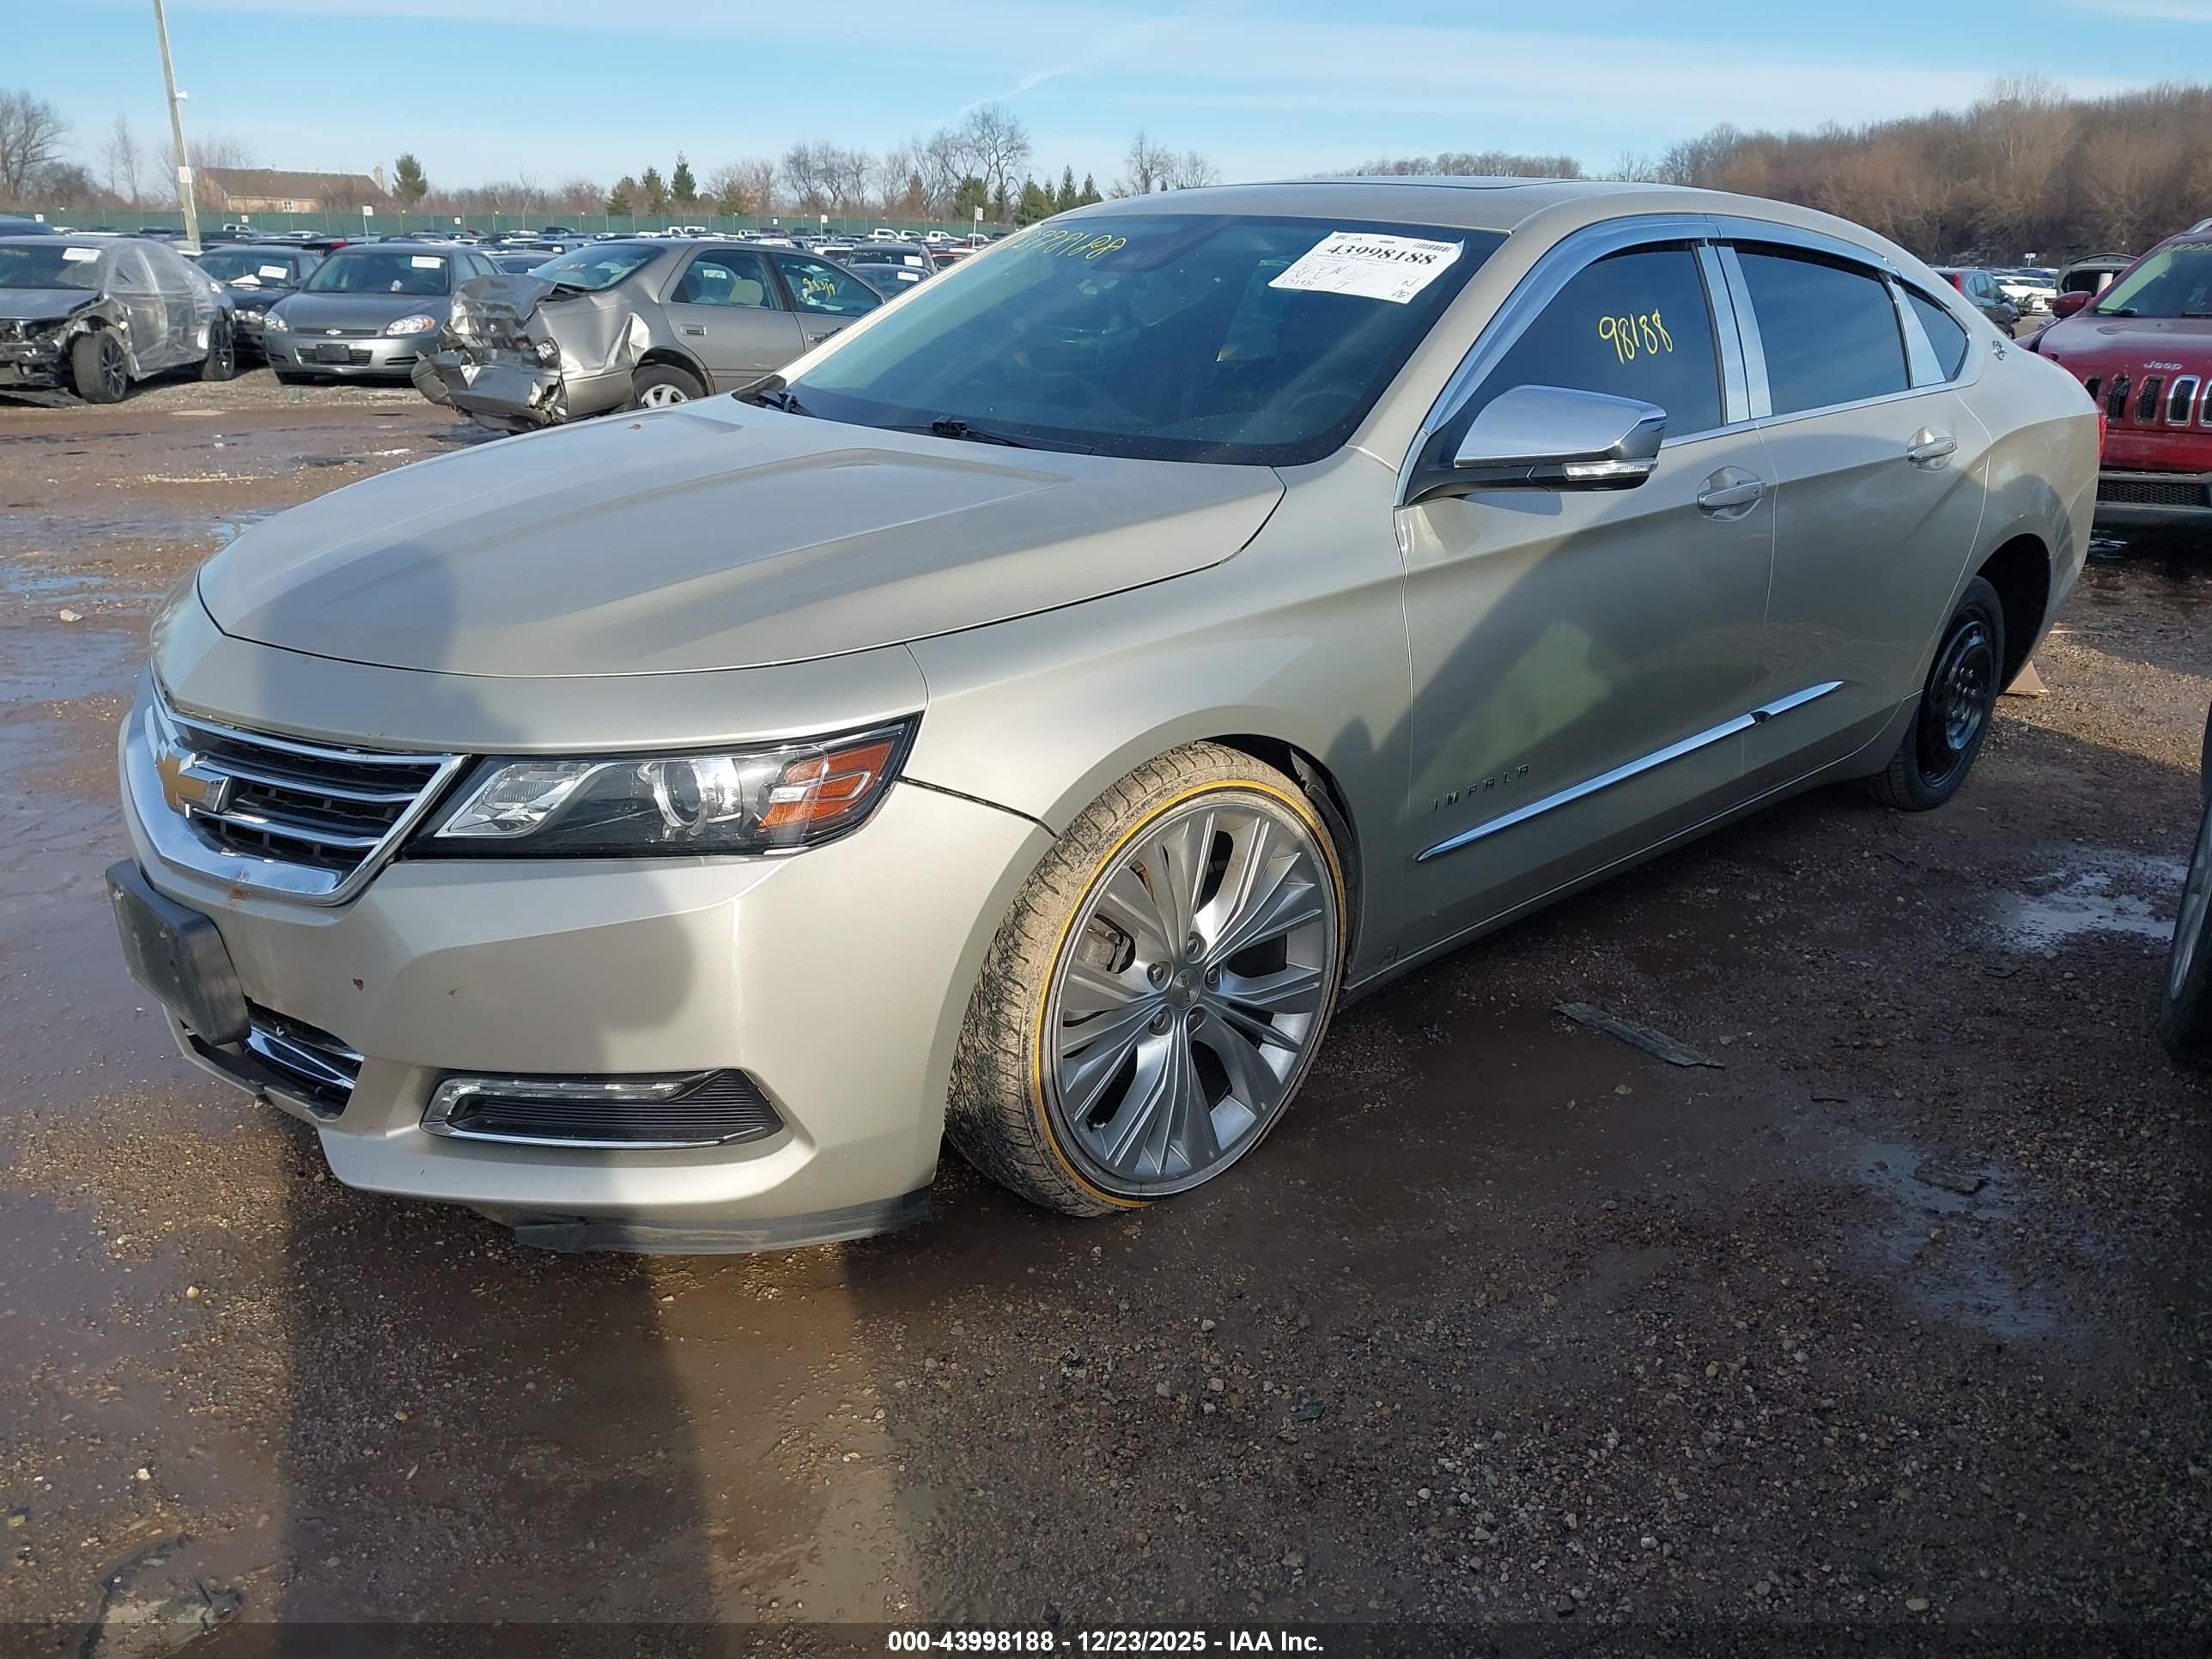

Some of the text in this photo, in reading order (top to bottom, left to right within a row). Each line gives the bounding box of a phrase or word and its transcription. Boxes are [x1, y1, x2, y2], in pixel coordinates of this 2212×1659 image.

[1326, 244, 1438, 265] 43998188
[1599, 308, 1674, 364] 98188
[2142, 361, 2184, 371] Jeep
[1430, 763, 1528, 811] IMPALA
